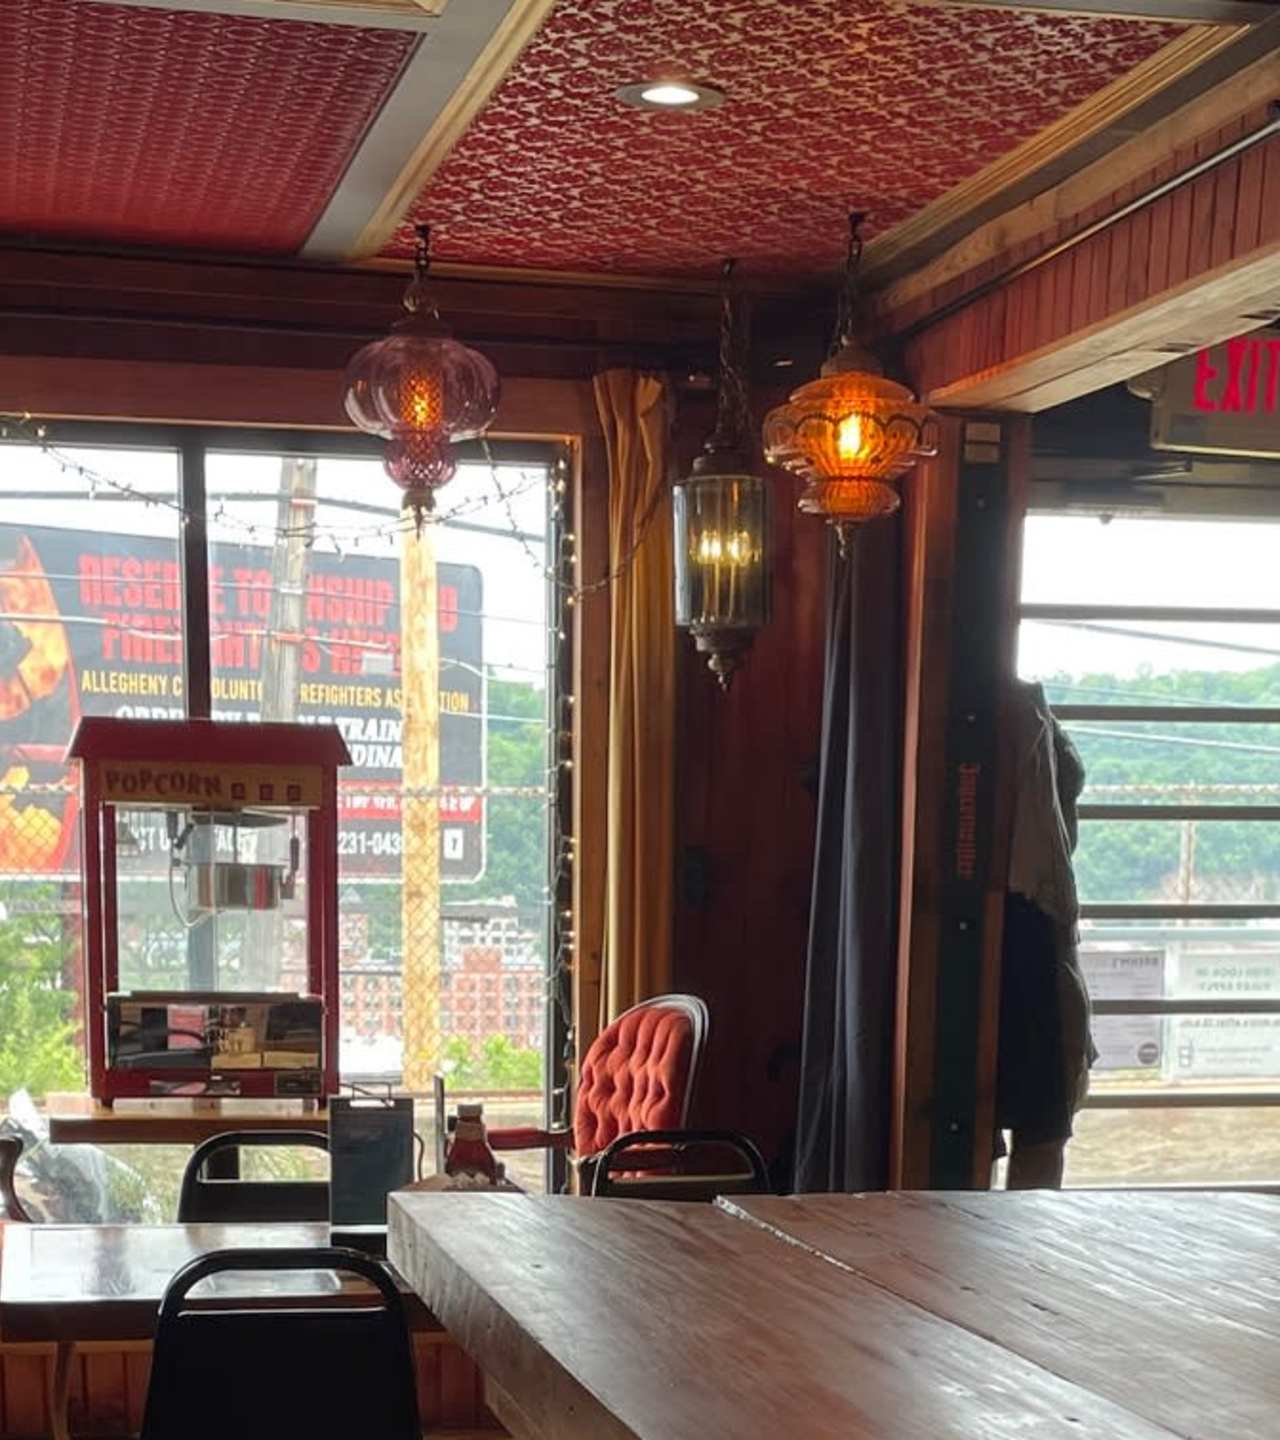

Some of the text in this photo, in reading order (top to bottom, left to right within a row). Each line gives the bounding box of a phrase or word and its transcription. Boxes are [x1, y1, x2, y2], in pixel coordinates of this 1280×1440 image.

[78, 552, 226, 616] RESERE
[81, 669, 168, 695] ALLEGHENY
[105, 768, 223, 798] POPCORN
